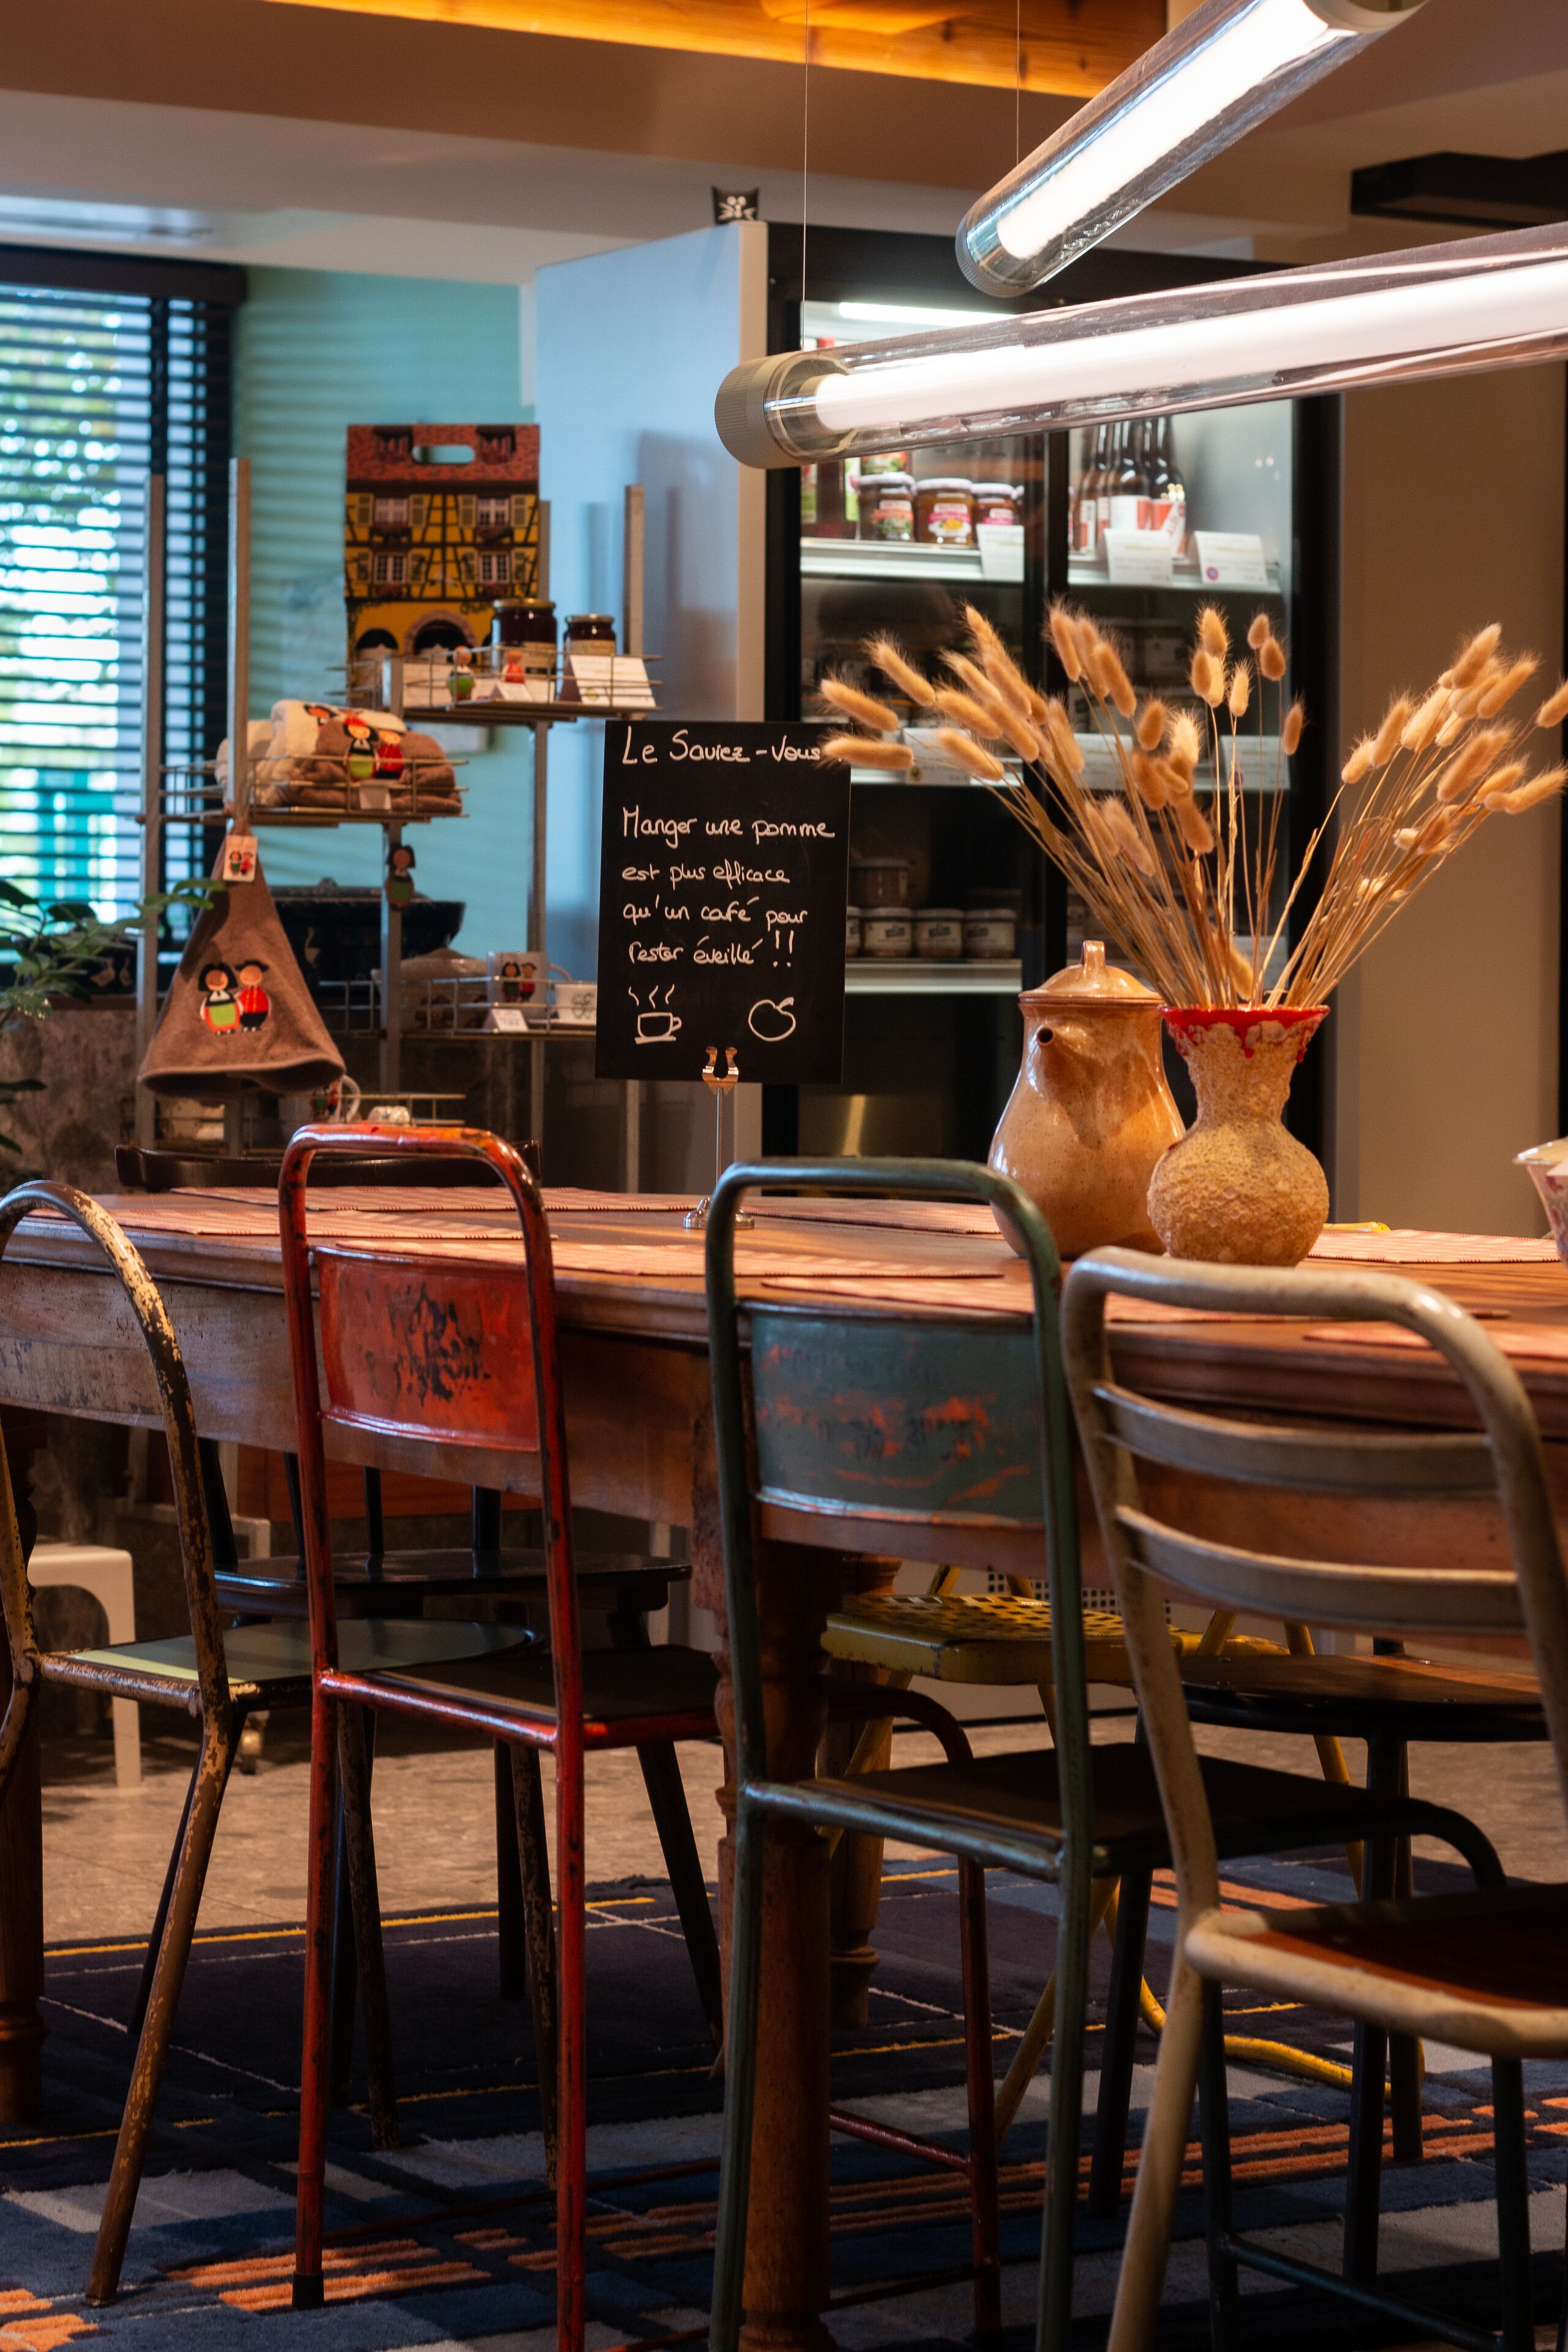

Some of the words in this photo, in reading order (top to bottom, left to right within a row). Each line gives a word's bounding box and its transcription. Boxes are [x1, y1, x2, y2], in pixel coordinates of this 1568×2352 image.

[622, 725, 658, 764] Le
[622, 804, 698, 849] Manger
[705, 819, 743, 835] une
[752, 820, 835, 845] pomme
[622, 863, 660, 881] est
[669, 863, 706, 891] plus
[712, 858, 790, 890] efficace
[623, 894, 690, 926] qu'un
[701, 896, 760, 922] café
[765, 910, 808, 932] pour
[693, 935, 763, 966] éveillé
